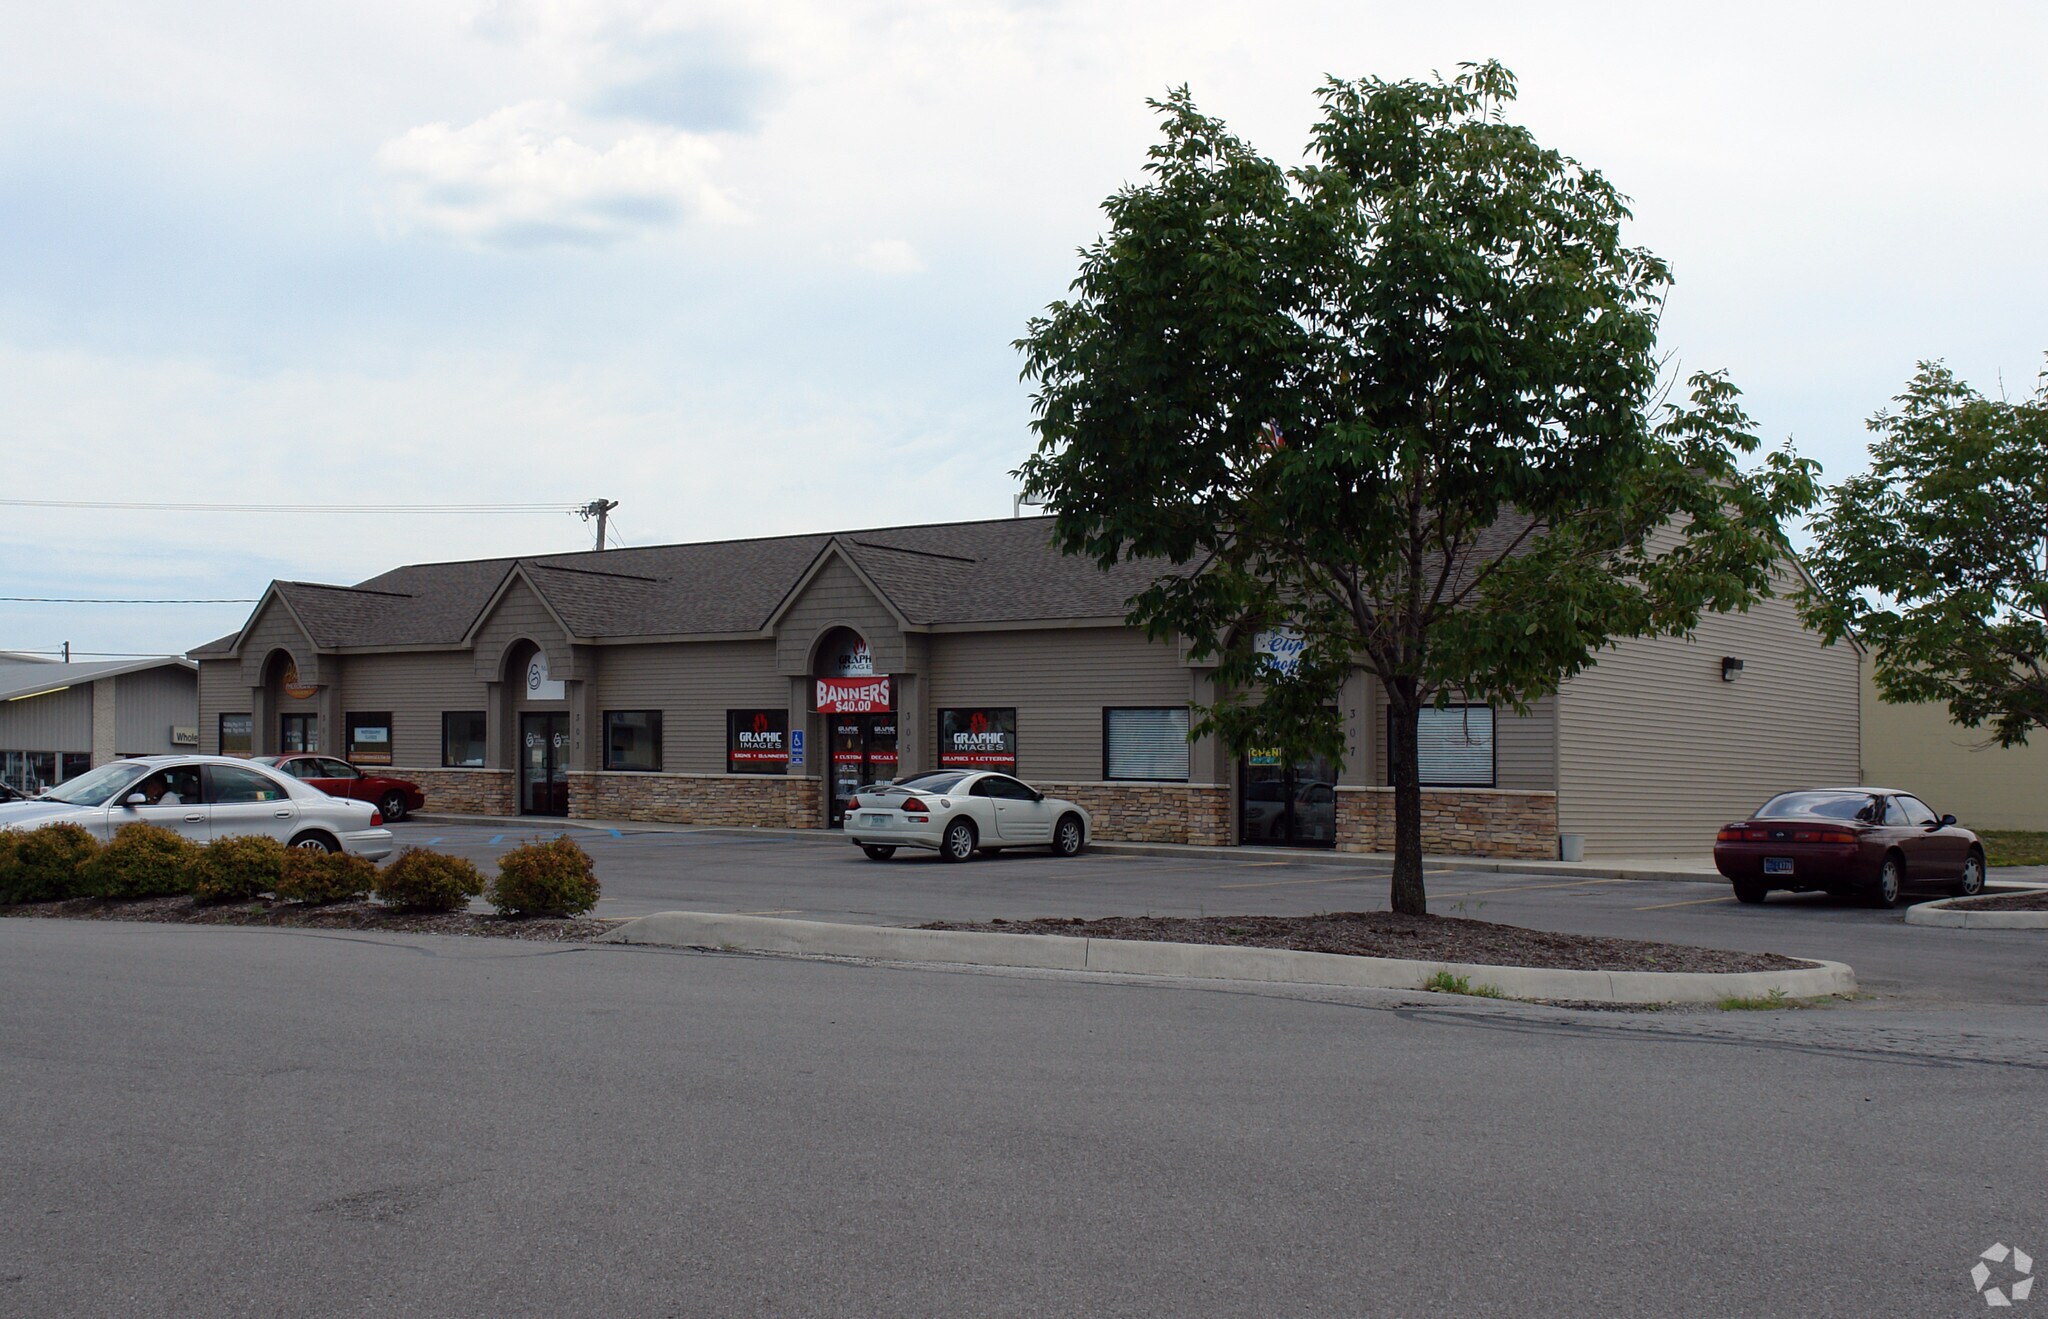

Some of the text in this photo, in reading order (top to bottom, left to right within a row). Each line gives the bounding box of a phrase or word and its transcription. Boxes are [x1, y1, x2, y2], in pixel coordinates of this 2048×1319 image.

[1267, 636, 1304, 656] Clip
[816, 679, 890, 708] BANNERS
[835, 700, 871, 713] $40.00
[739, 731, 782, 743] GRAPHIC
[953, 732, 1004, 744] GRAPHIC
[954, 743, 1004, 751] IMAGES
